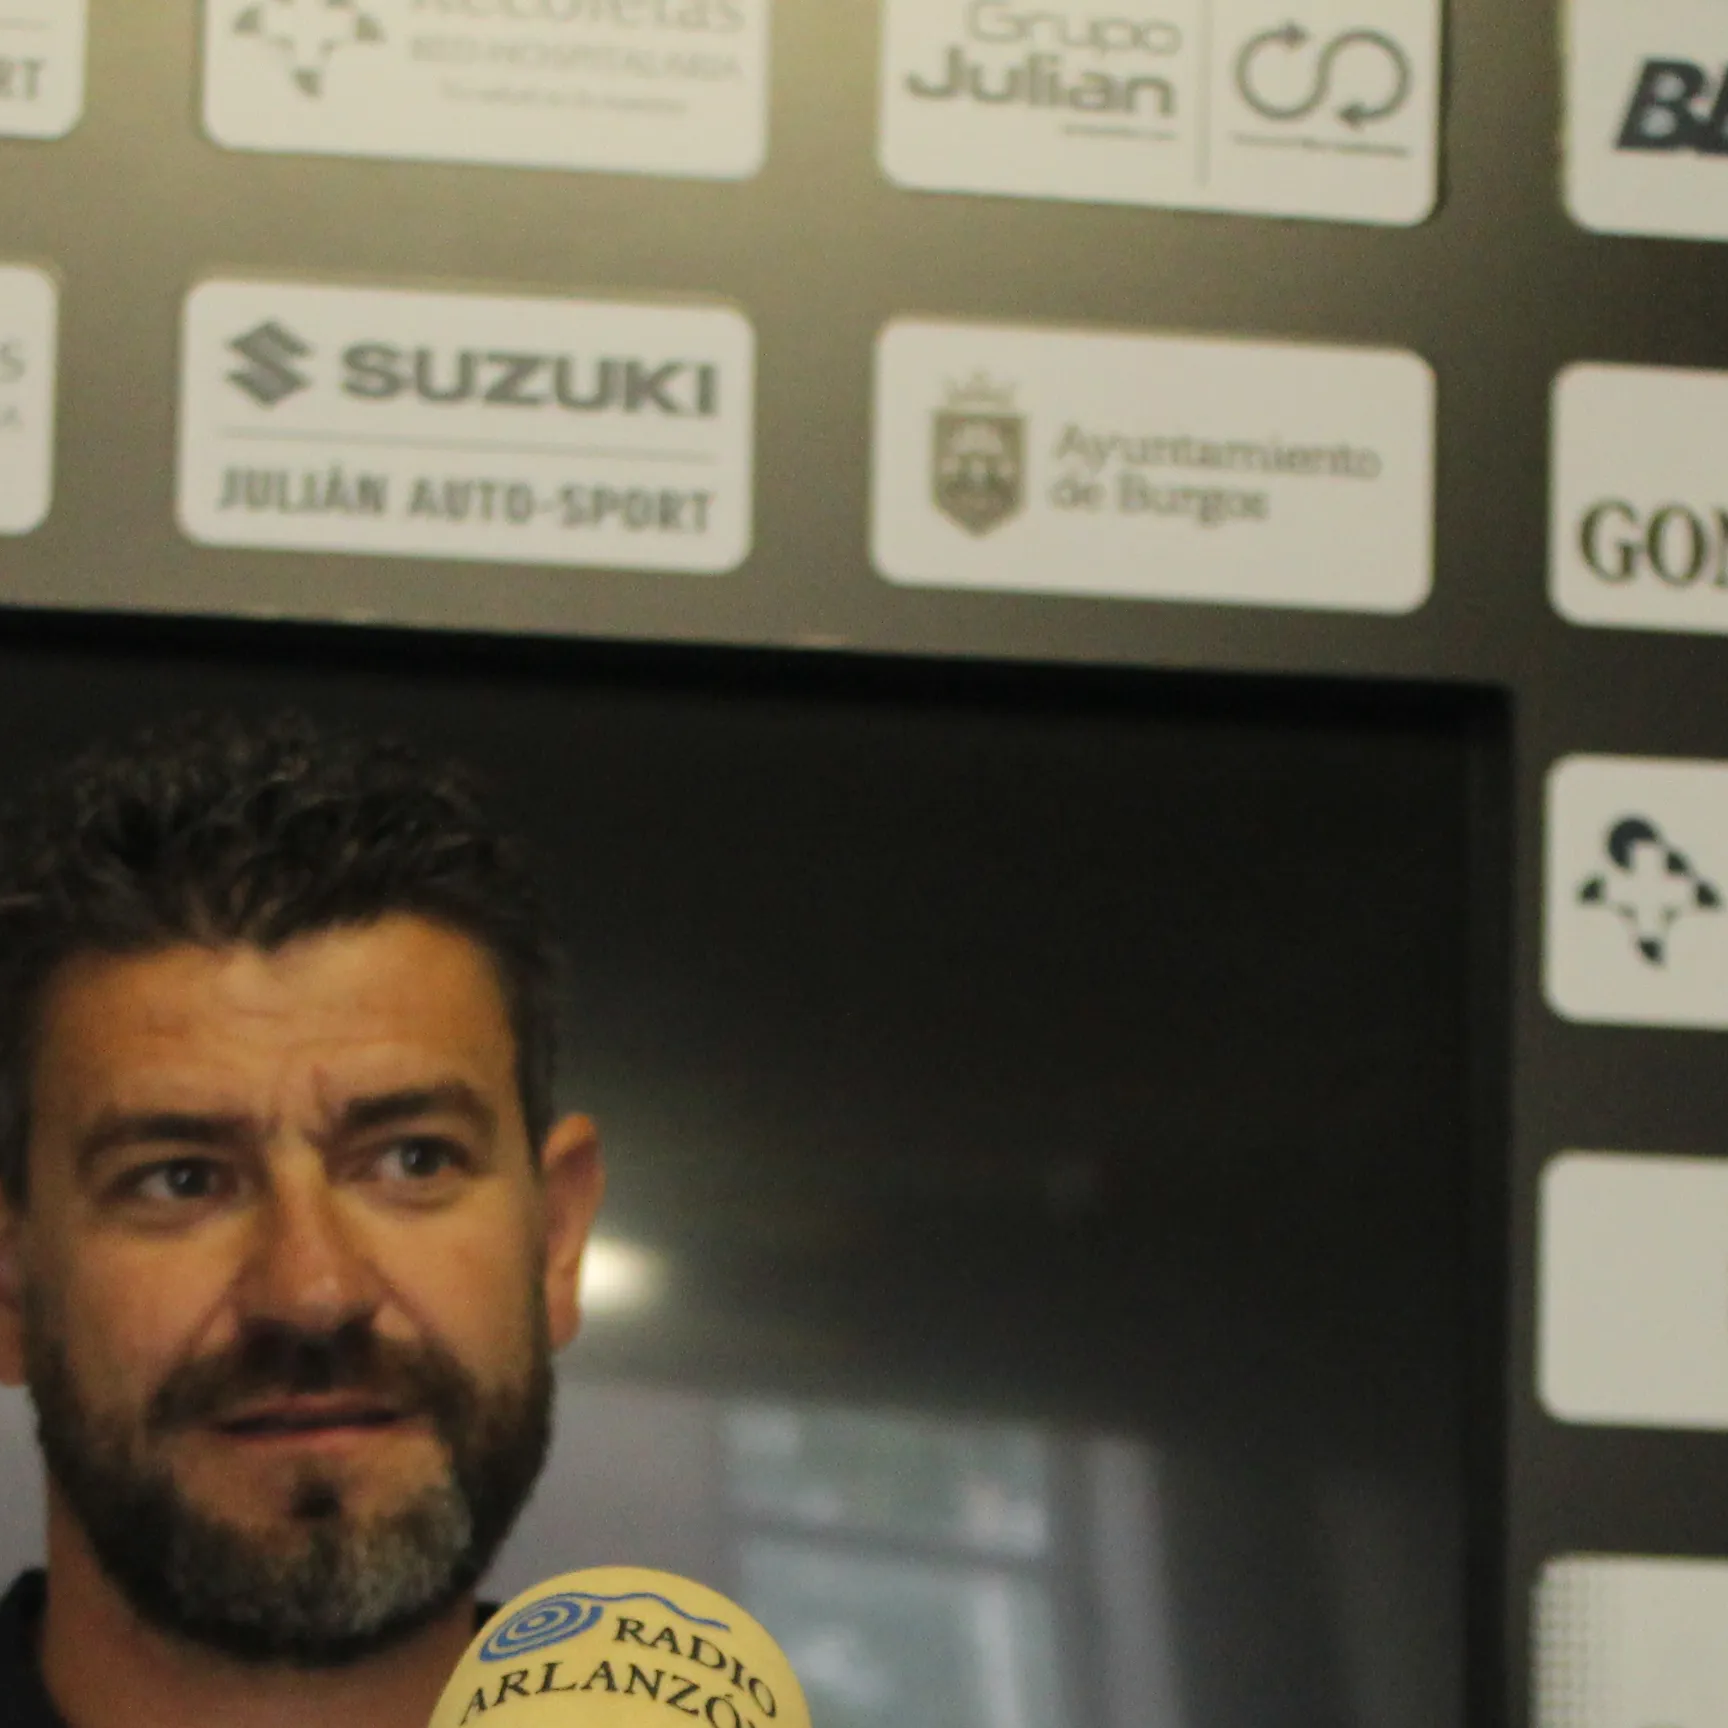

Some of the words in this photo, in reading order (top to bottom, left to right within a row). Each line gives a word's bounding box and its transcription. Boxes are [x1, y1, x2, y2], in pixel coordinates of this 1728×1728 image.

[964, 0, 1184, 55] Grupo
[904, 44, 1176, 118] Julian
[339, 340, 721, 420] SUZUKI
[1054, 420, 1382, 482] Ayuntamiento
[218, 464, 388, 520] JULIÁN
[407, 476, 715, 538] AUTO-SPORT
[1051, 470, 1108, 514] de
[1118, 475, 1269, 528] Burgos
[615, 1616, 778, 1719] RADIO
